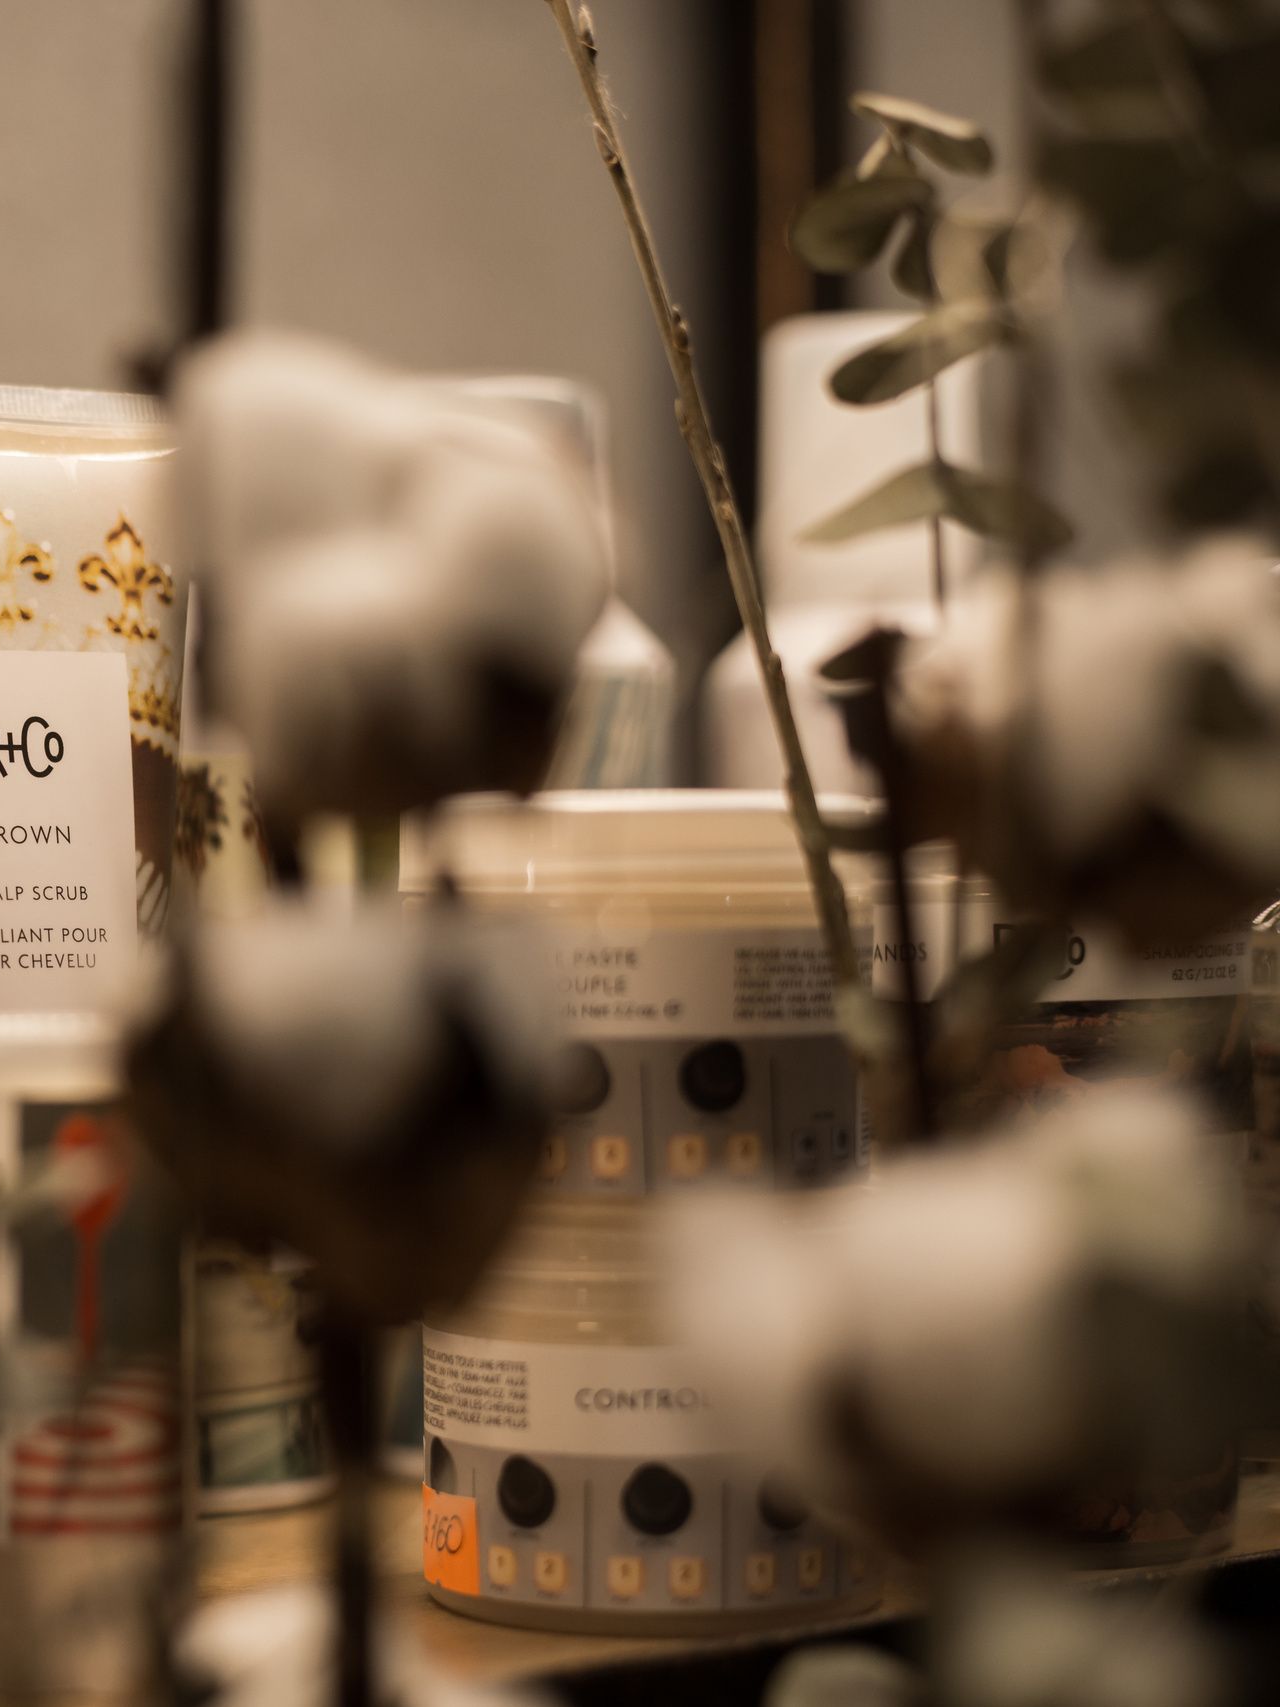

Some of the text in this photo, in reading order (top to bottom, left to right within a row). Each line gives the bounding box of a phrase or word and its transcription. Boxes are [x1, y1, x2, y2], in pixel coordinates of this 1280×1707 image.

[32, 886, 88, 901] SCRUB
[62, 928, 109, 943] POUR
[874, 942, 927, 962] ANDS
[1143, 943, 1232, 960] SHAMPOOING
[18, 953, 97, 969] CHEVELU
[558, 975, 628, 996] OUPLE
